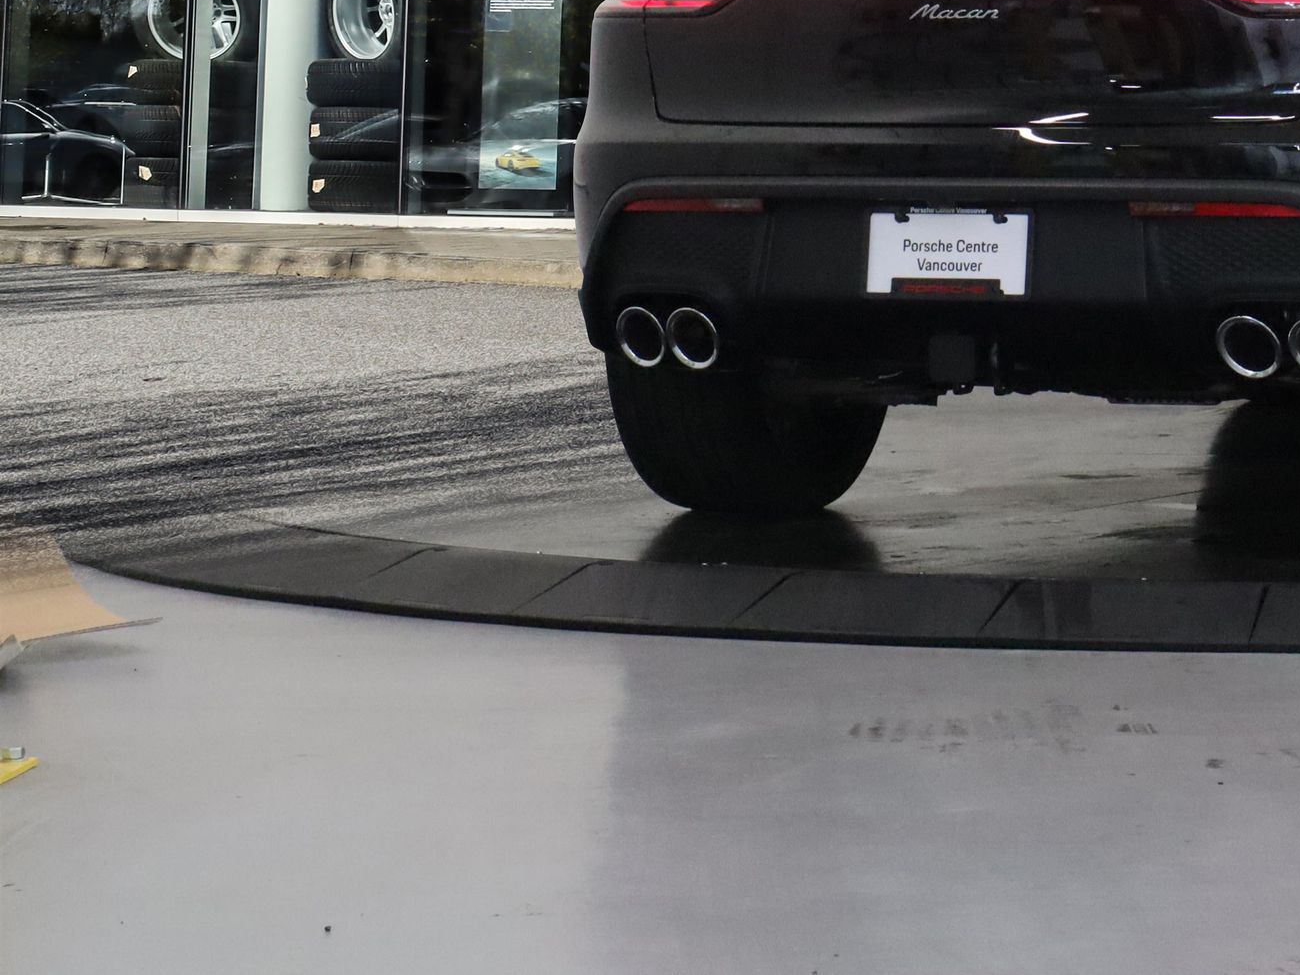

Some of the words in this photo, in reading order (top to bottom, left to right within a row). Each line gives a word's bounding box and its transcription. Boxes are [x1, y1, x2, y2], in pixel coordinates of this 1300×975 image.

[909, 3, 1001, 21] Macan
[909, 206, 934, 214] Porsche
[903, 238, 953, 253] Porsche
[956, 239, 999, 254] Centre
[917, 258, 983, 272] Vancouver
